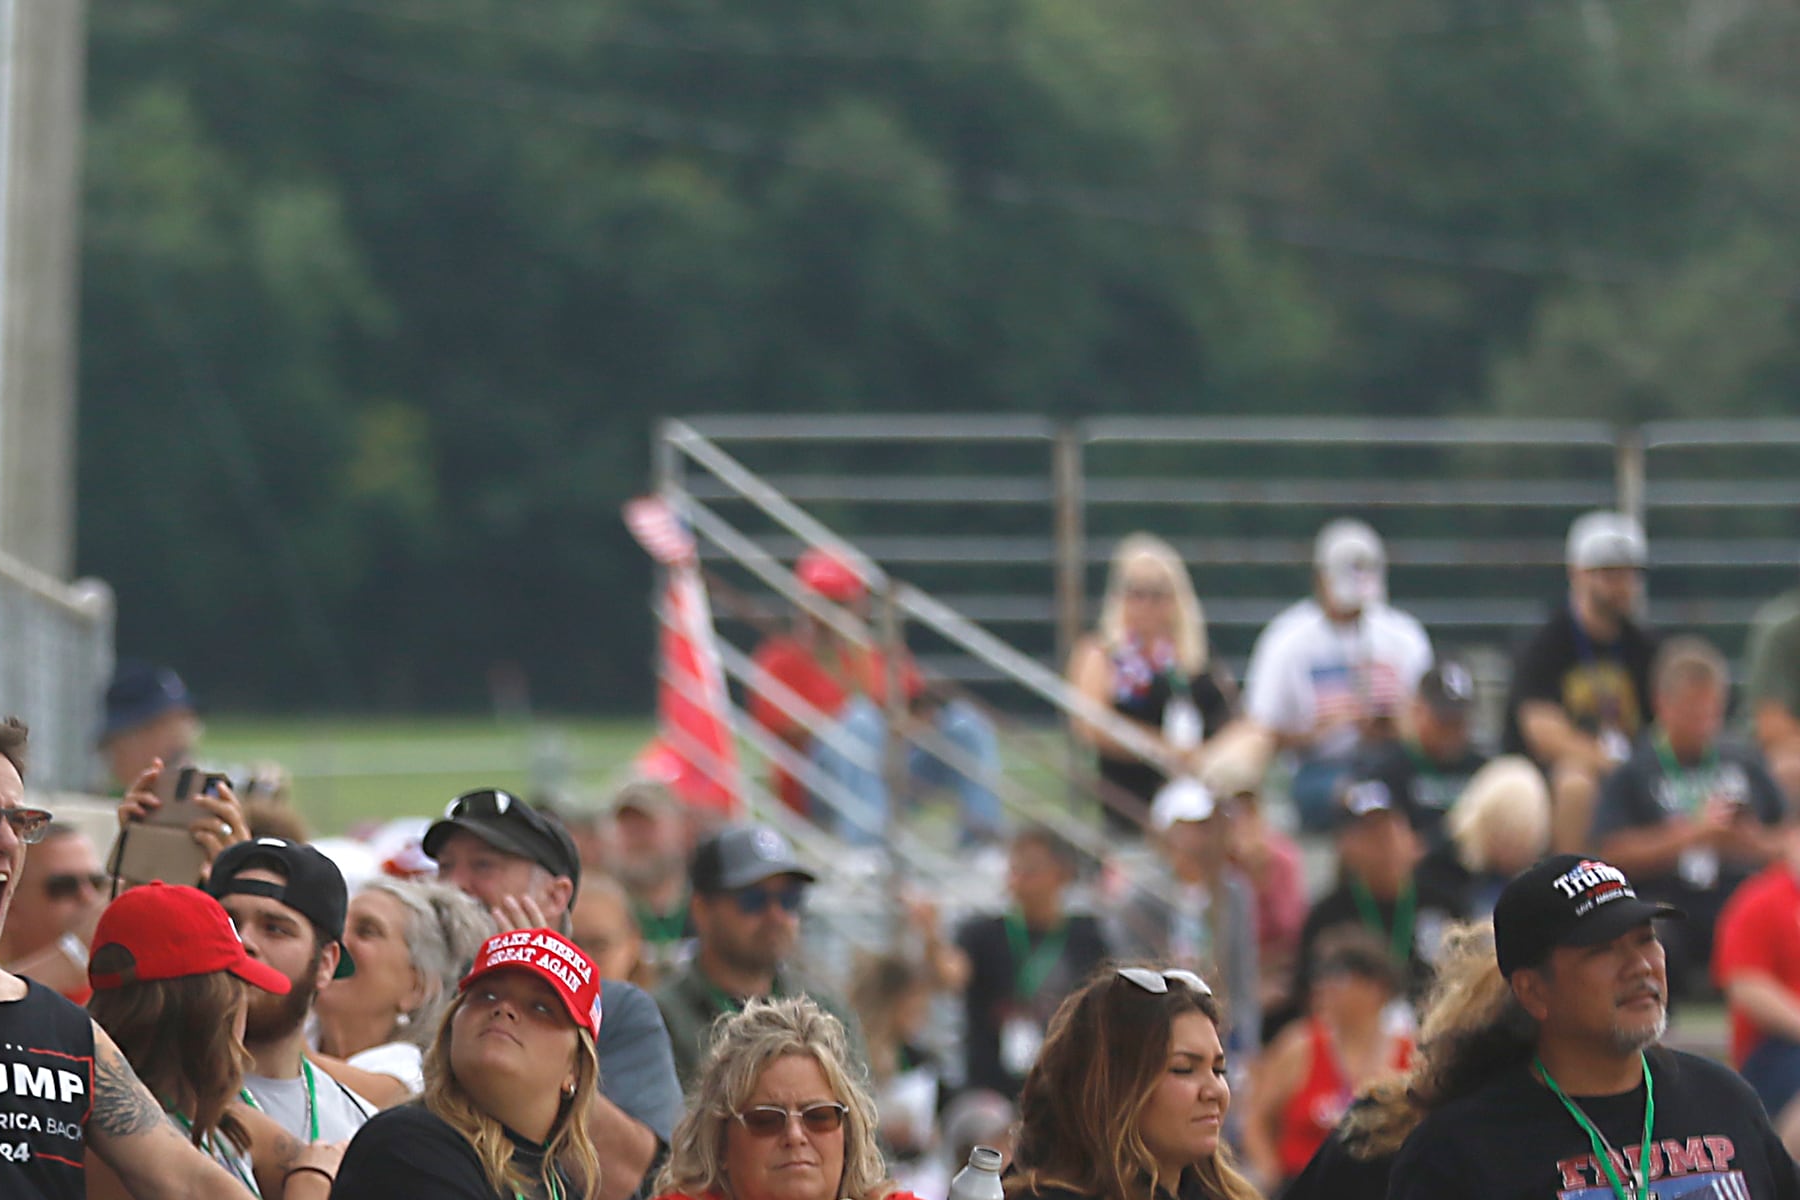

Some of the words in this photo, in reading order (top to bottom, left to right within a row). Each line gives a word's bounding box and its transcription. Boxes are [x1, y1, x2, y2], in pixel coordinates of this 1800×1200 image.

[486, 933, 531, 954] MAKE
[530, 934, 592, 985] AMERICA
[486, 947, 537, 967] GREAT
[536, 953, 582, 993] AGAIN
